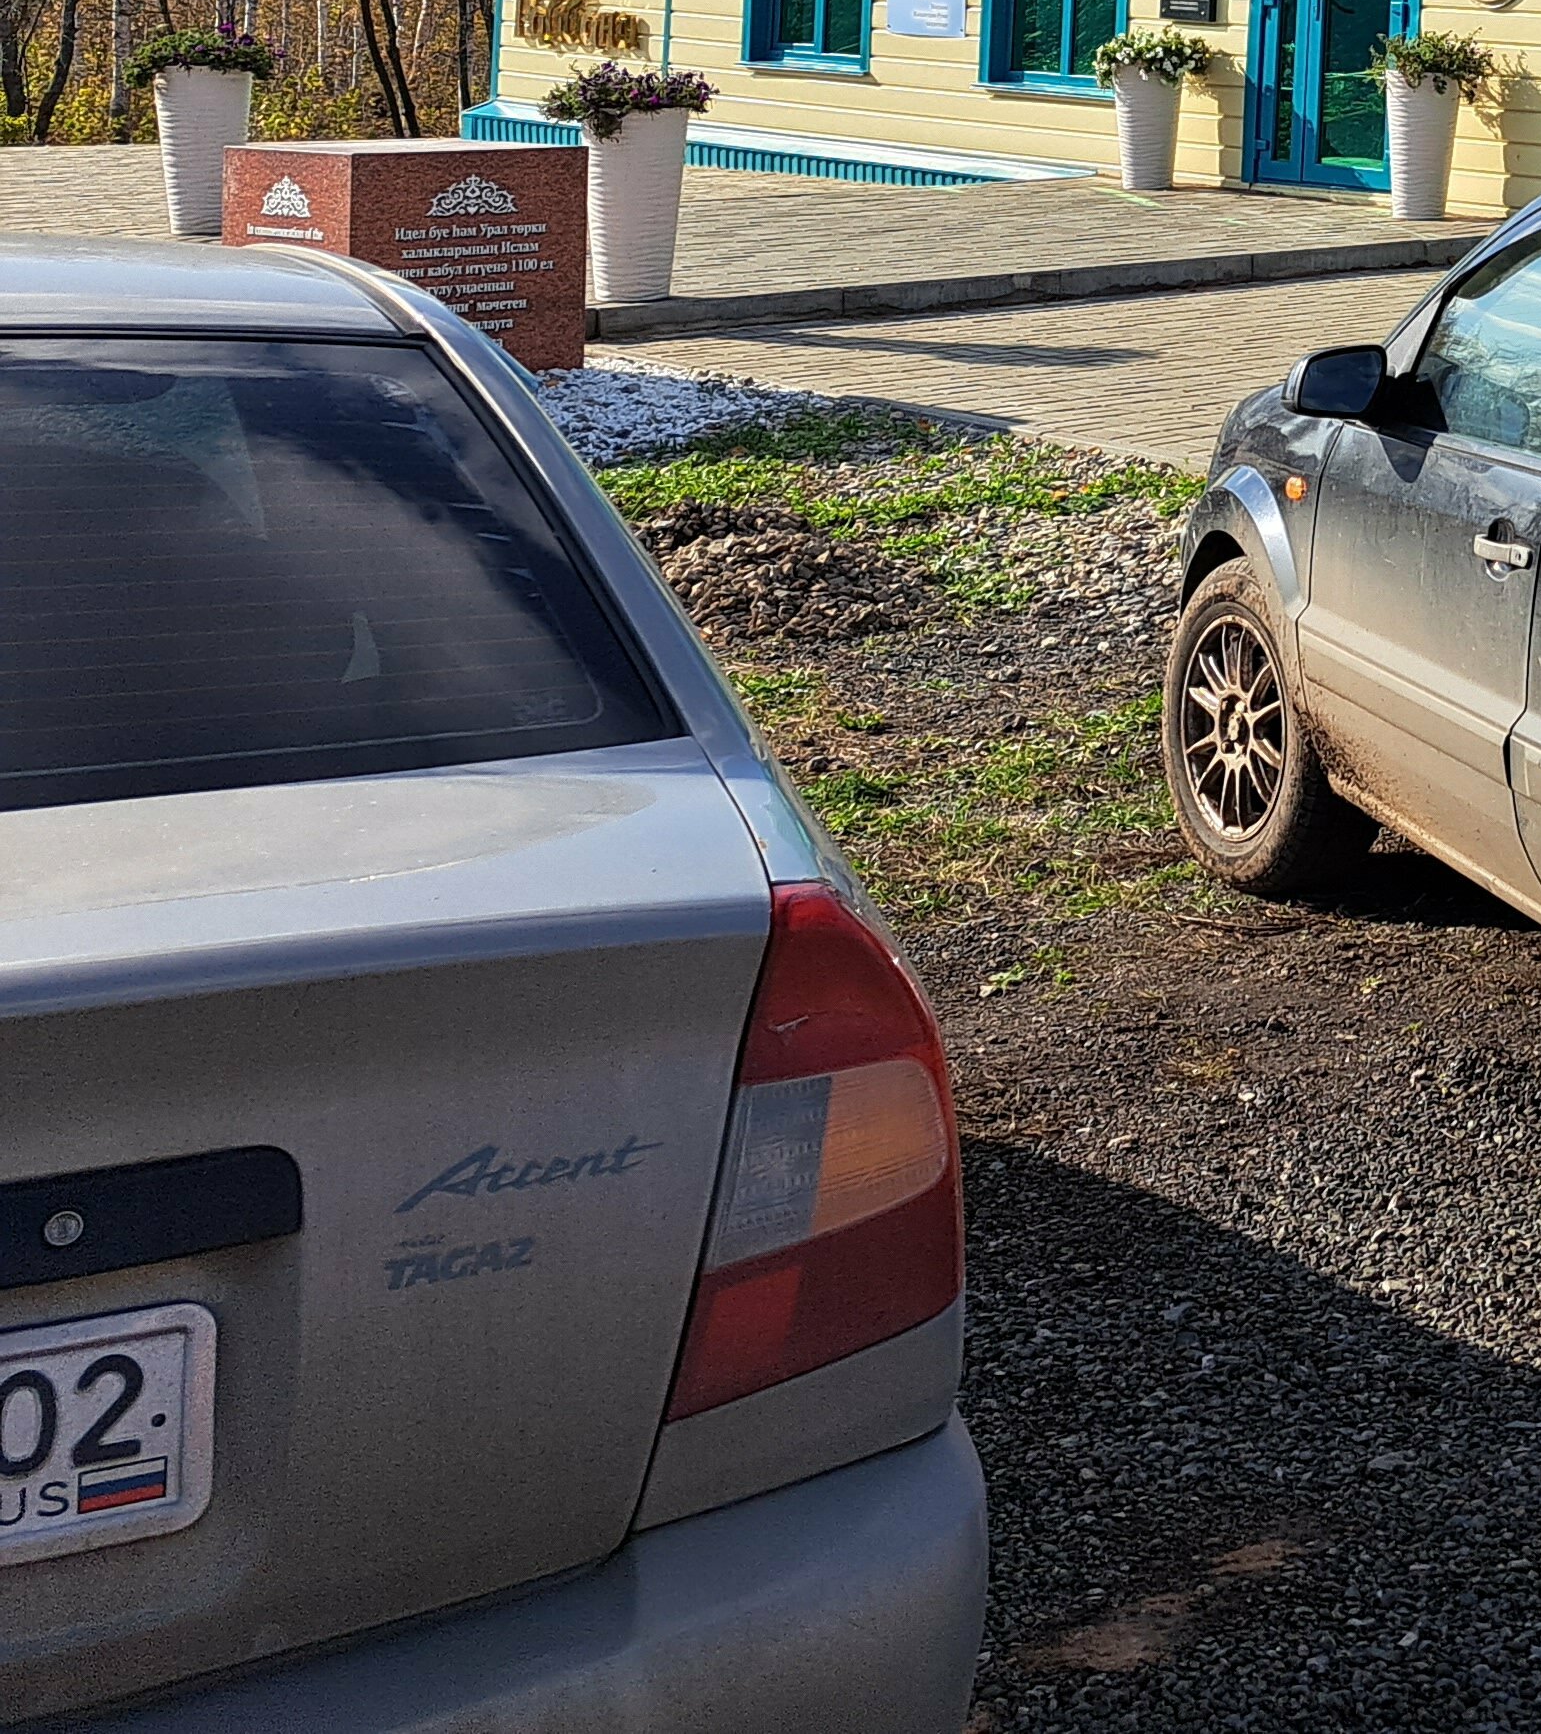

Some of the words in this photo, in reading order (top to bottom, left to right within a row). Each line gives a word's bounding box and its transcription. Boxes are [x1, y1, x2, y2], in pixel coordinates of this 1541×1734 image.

[394, 227, 426, 241] Идел
[429, 225, 450, 241] буе
[479, 223, 508, 237] Урал
[501, 241, 540, 254] Ислам
[427, 264, 462, 281] кабул
[511, 259, 538, 272] 1100
[393, 1133, 666, 1215] Accent
